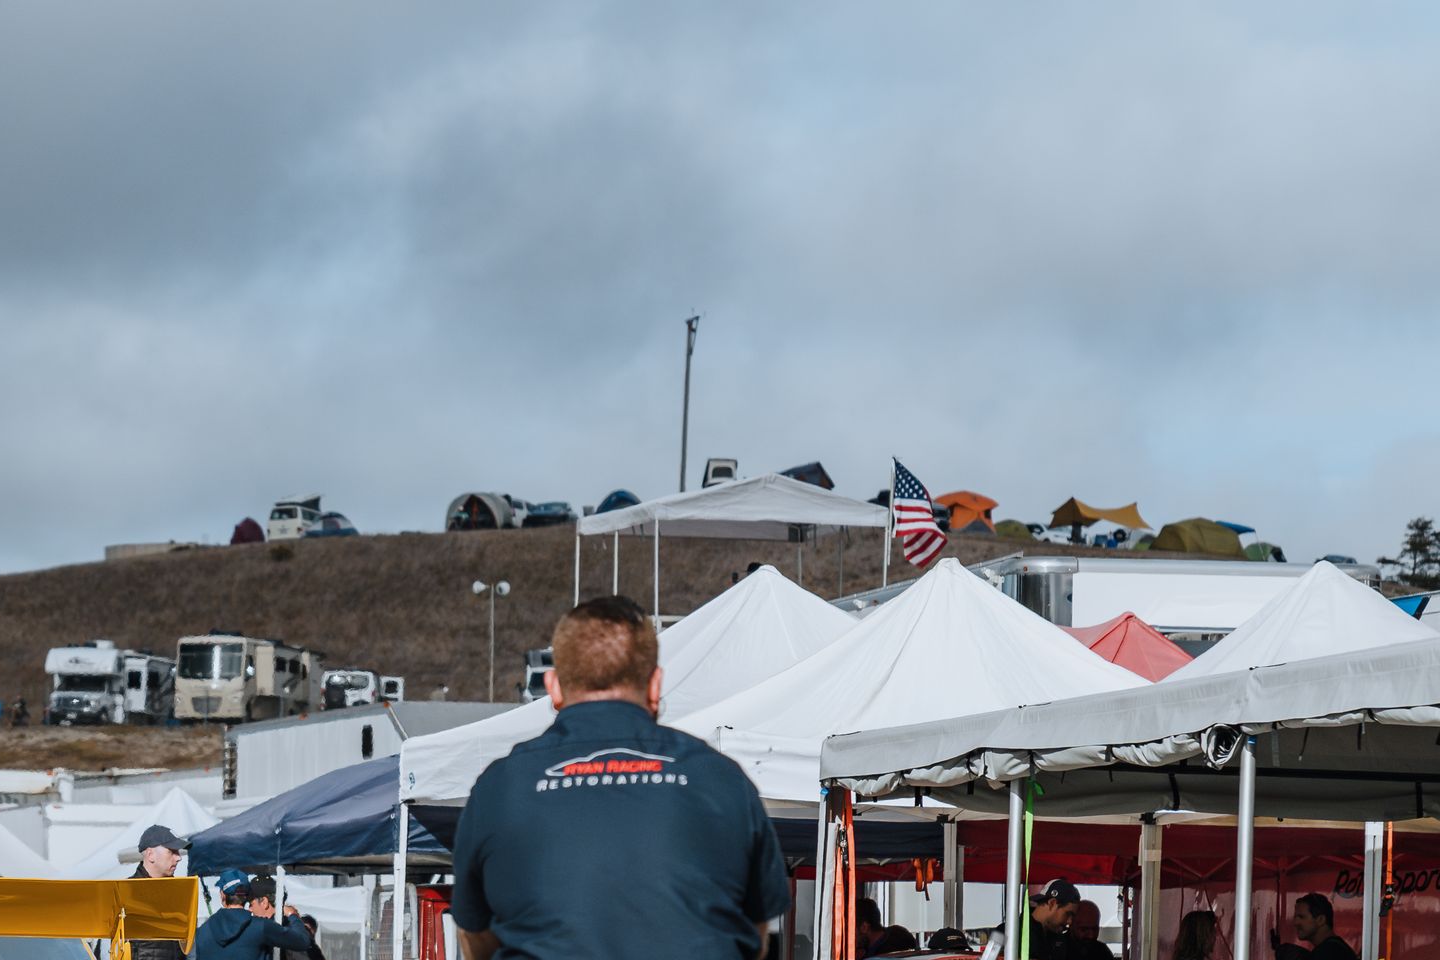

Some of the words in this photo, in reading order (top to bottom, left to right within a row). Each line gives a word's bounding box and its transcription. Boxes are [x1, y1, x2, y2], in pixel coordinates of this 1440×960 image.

[563, 761, 605, 776] RYAN
[606, 760, 663, 774] RACING
[536, 773, 689, 792] RESTORATIONS
